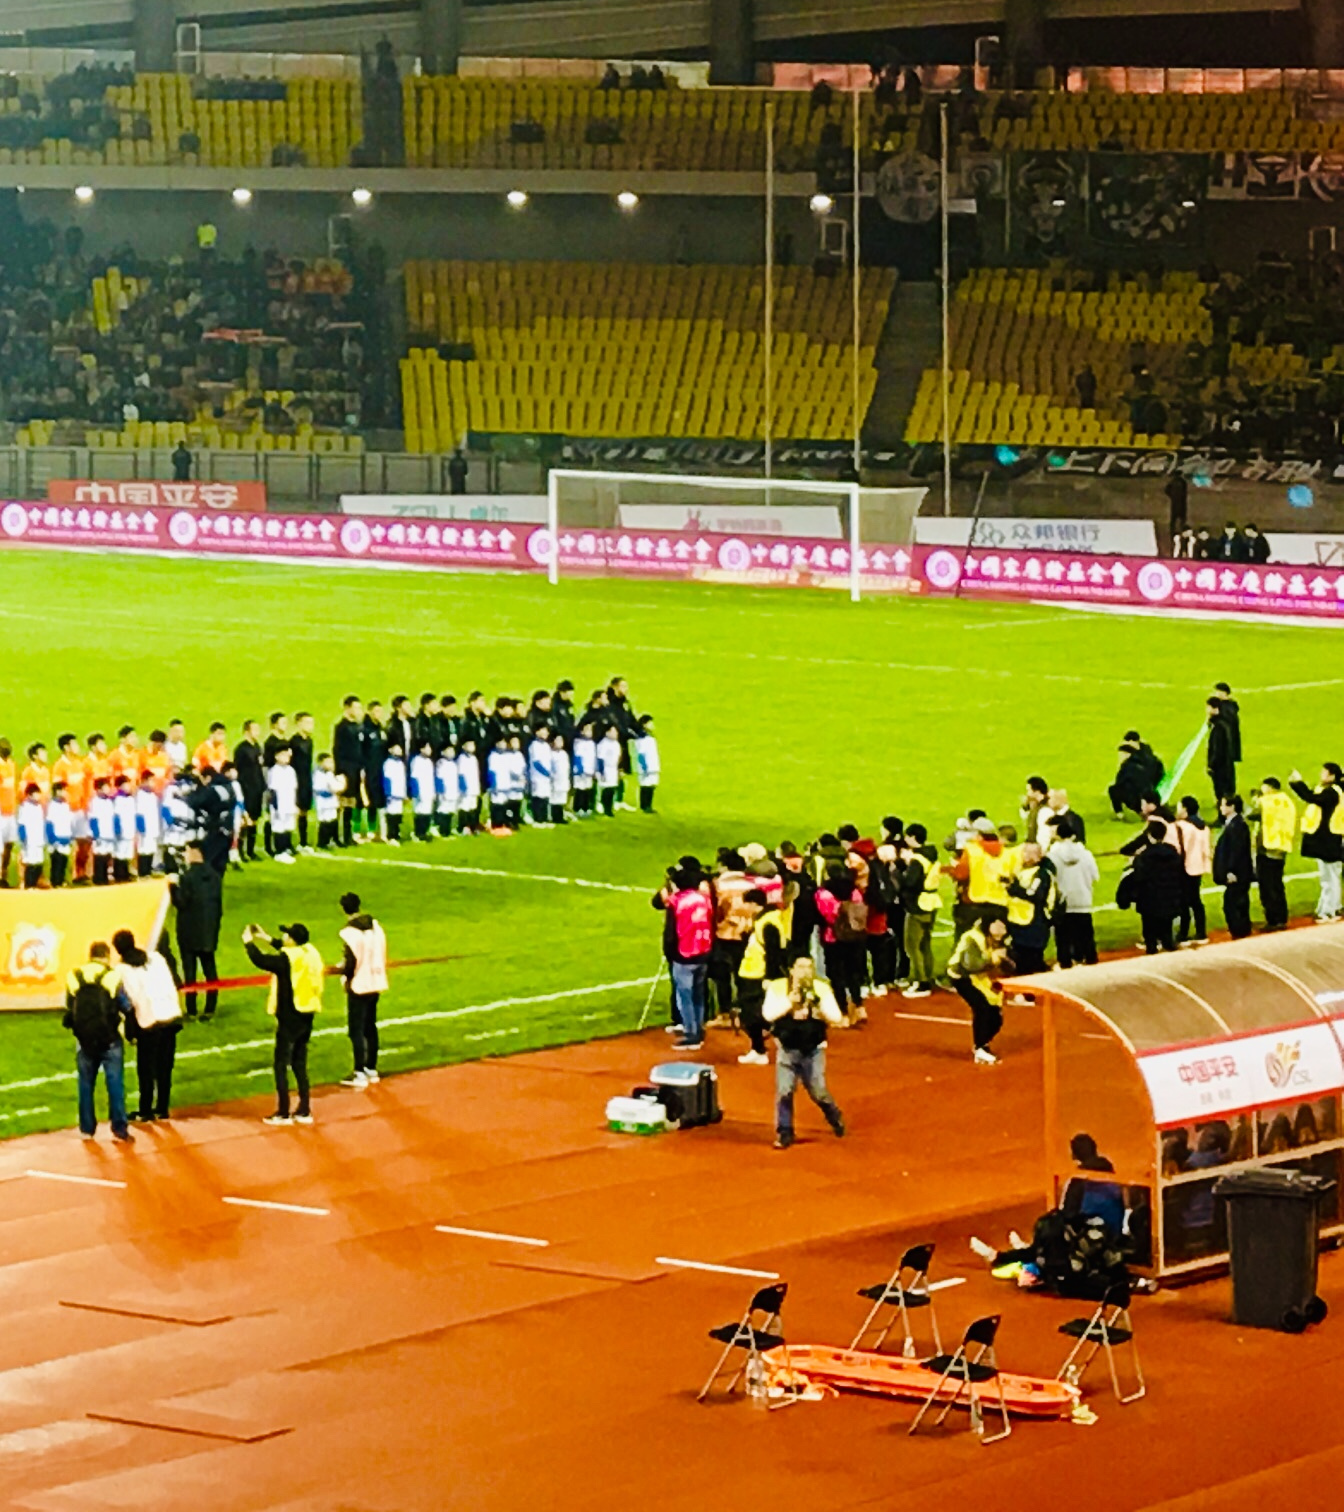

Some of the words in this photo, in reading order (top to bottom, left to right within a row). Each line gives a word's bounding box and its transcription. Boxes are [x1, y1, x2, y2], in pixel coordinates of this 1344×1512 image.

[75, 482, 238, 509] 中国平安
[1178, 1055, 1237, 1085] 中国平安
